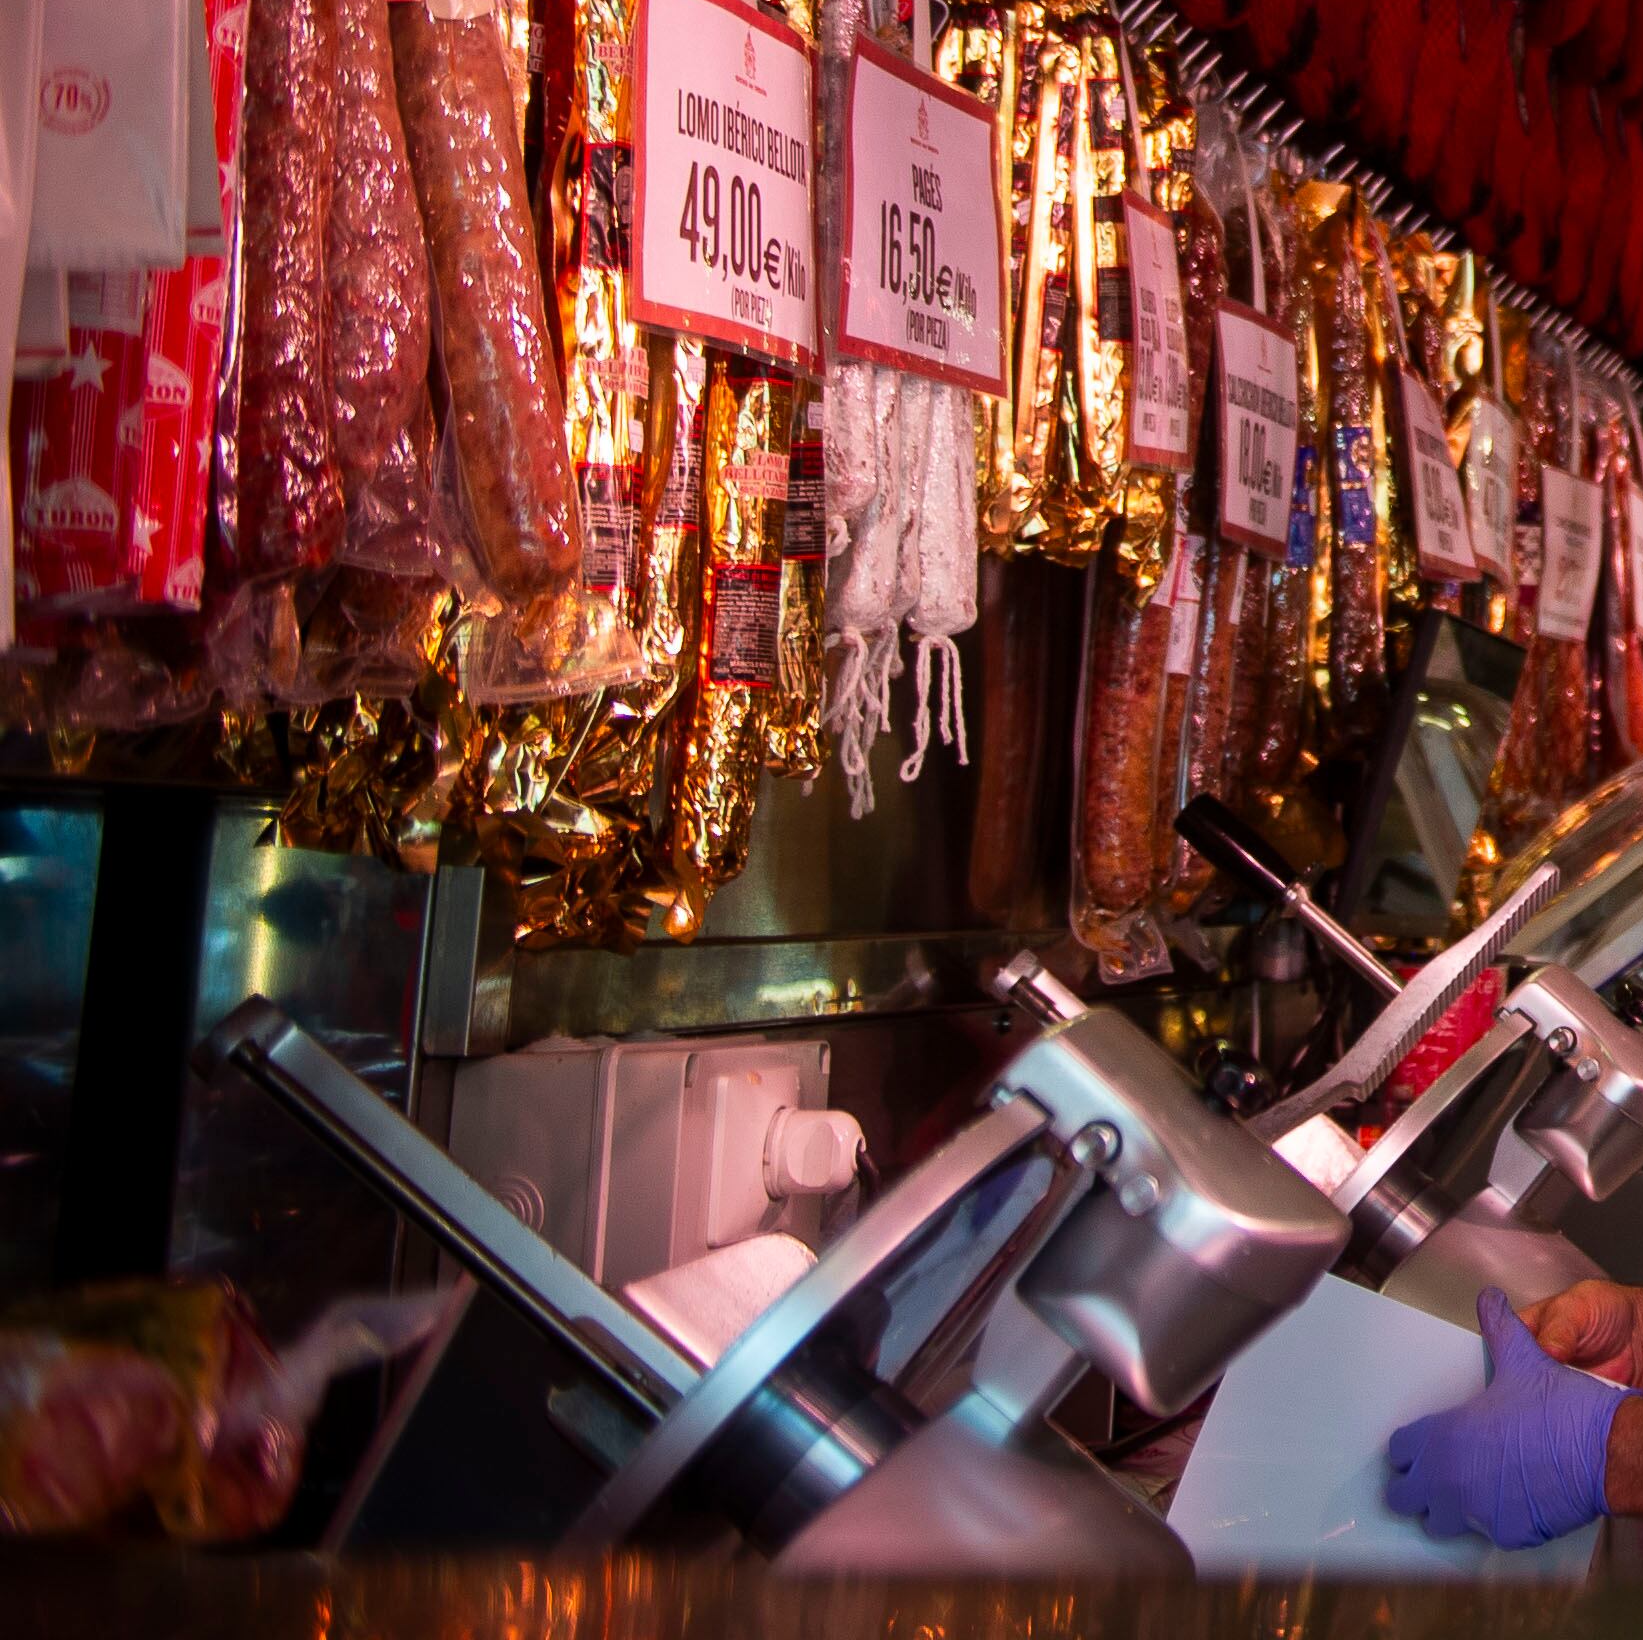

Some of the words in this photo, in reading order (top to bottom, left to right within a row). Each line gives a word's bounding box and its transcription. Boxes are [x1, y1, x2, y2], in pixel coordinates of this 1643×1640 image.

[678, 88, 719, 146] LOMO
[723, 100, 765, 166] IBÉRICO
[767, 125, 807, 188] BELLOTA
[926, 315, 950, 355] PIEZA)
